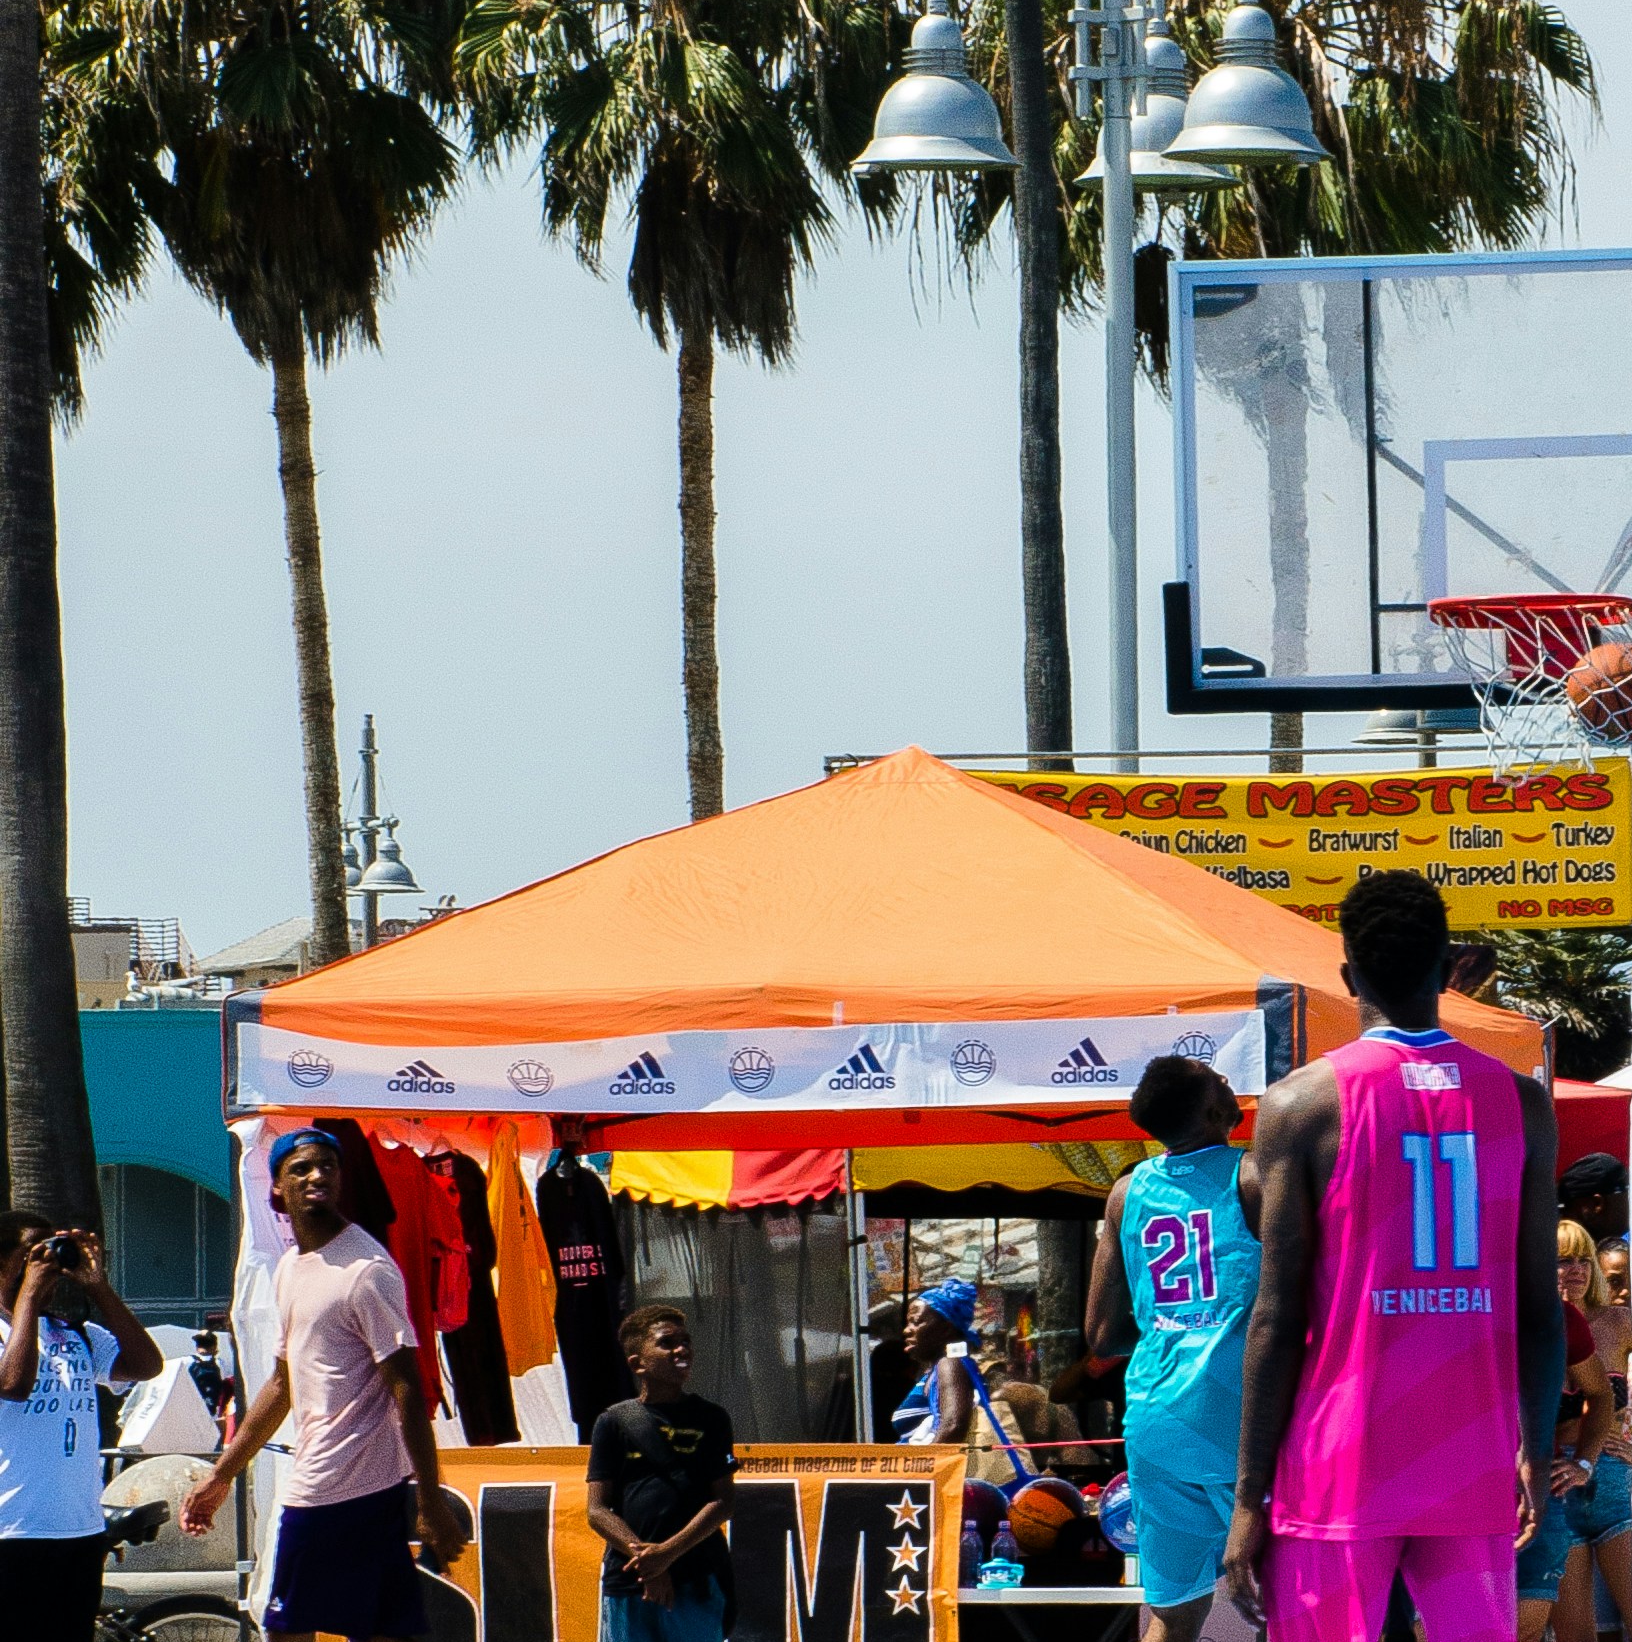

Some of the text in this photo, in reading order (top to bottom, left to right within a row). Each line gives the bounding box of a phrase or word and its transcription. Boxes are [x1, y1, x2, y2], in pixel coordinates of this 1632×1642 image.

[1000, 773, 1614, 820] SAGE MASTERS
[1174, 829, 1248, 855] Chicken
[1308, 828, 1399, 853] Bratwurst
[1449, 824, 1503, 850] Italian
[1551, 821, 1614, 848] Turkey
[1426, 860, 1516, 888] Wrapped
[1522, 860, 1559, 885] Hot
[1565, 859, 1616, 884] Dogs
[1498, 897, 1613, 919] NO MSG
[828, 1071, 896, 1090] adidas
[1051, 1065, 1119, 1084] adidas
[387, 1077, 455, 1095] adidas
[609, 1079, 676, 1096] adidas
[1401, 1131, 1480, 1271] 11
[1141, 1209, 1217, 1306] 21
[24, 1398, 60, 1415] TOO
[880, 1457, 899, 1472] all
[903, 1456, 936, 1472] time
